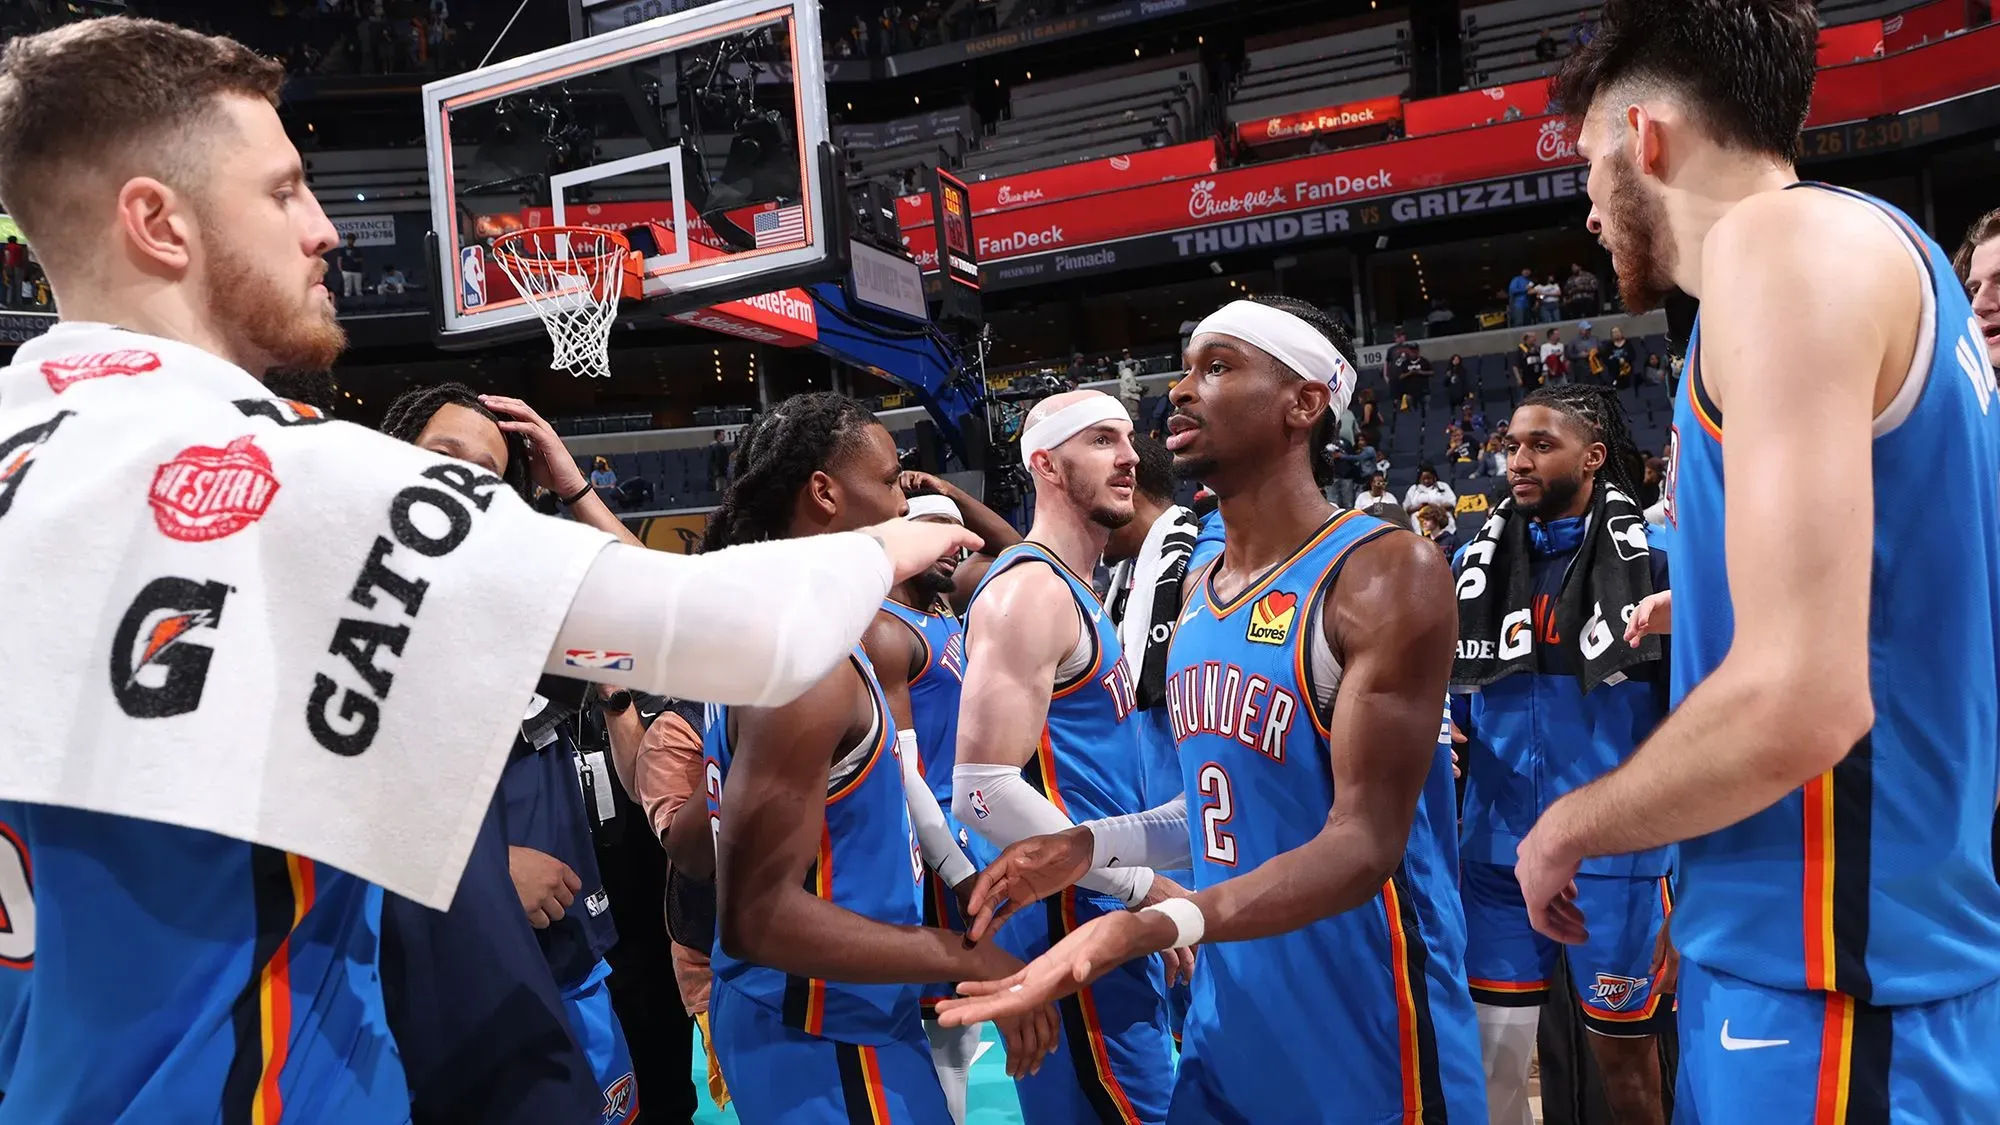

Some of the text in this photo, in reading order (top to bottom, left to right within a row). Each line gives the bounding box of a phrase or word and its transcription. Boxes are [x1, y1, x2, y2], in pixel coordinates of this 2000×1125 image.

[1319, 108, 1374, 129] FanDeck
[1816, 131, 1842, 155] 26
[1295, 168, 1392, 202] FanDeck
[978, 225, 1064, 256] FanDeck
[1172, 208, 1350, 257] THUNDER
[1360, 206, 1380, 225] VS
[1055, 248, 1116, 271] Pinnacle
[1363, 351, 1382, 364] 109
[155, 463, 274, 514] WESTERN
[110, 575, 232, 719] G
[1166, 660, 1298, 765] HUNDER
[1199, 761, 1238, 866] 2
[1596, 983, 1626, 997] OKC
